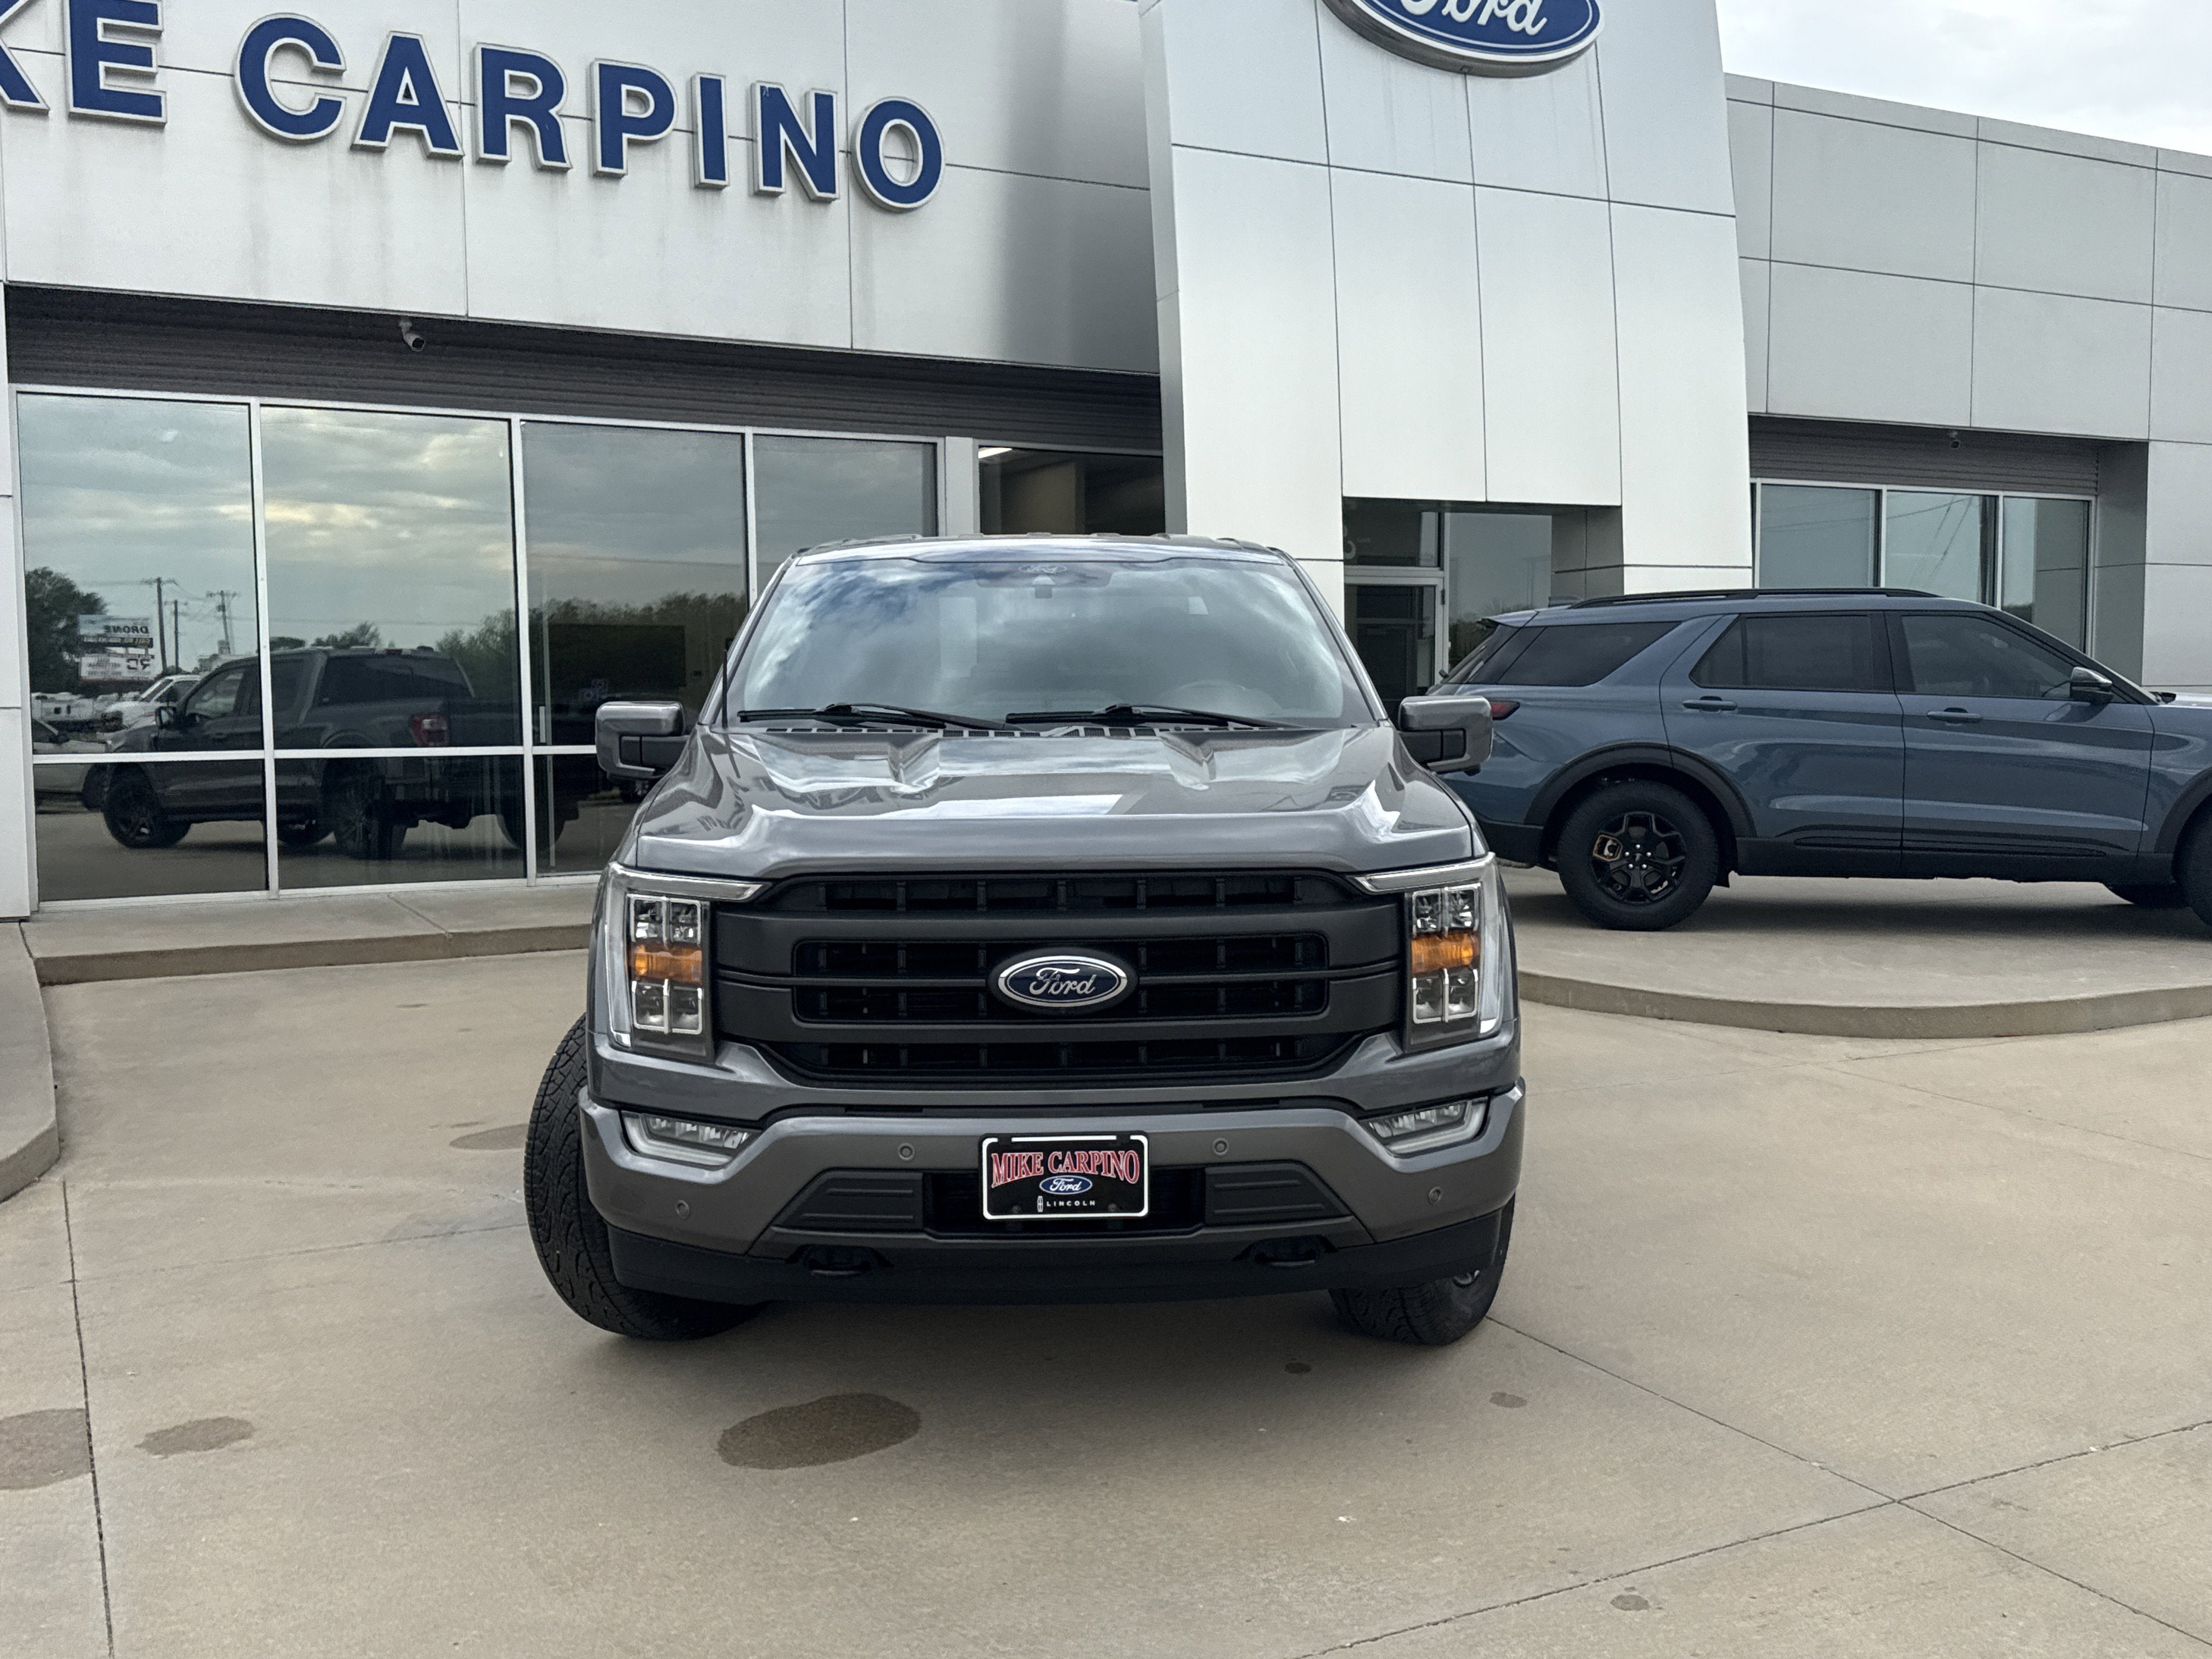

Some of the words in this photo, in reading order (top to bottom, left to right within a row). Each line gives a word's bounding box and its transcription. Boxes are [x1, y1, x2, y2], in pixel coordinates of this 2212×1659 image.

[233, 11, 945, 212] CARPINO
[1029, 967, 1096, 995] Ford
[991, 1152, 1043, 1188] MIKE
[1047, 1150, 1139, 1184] CARPINO
[1048, 1177, 1082, 1192] Ford
